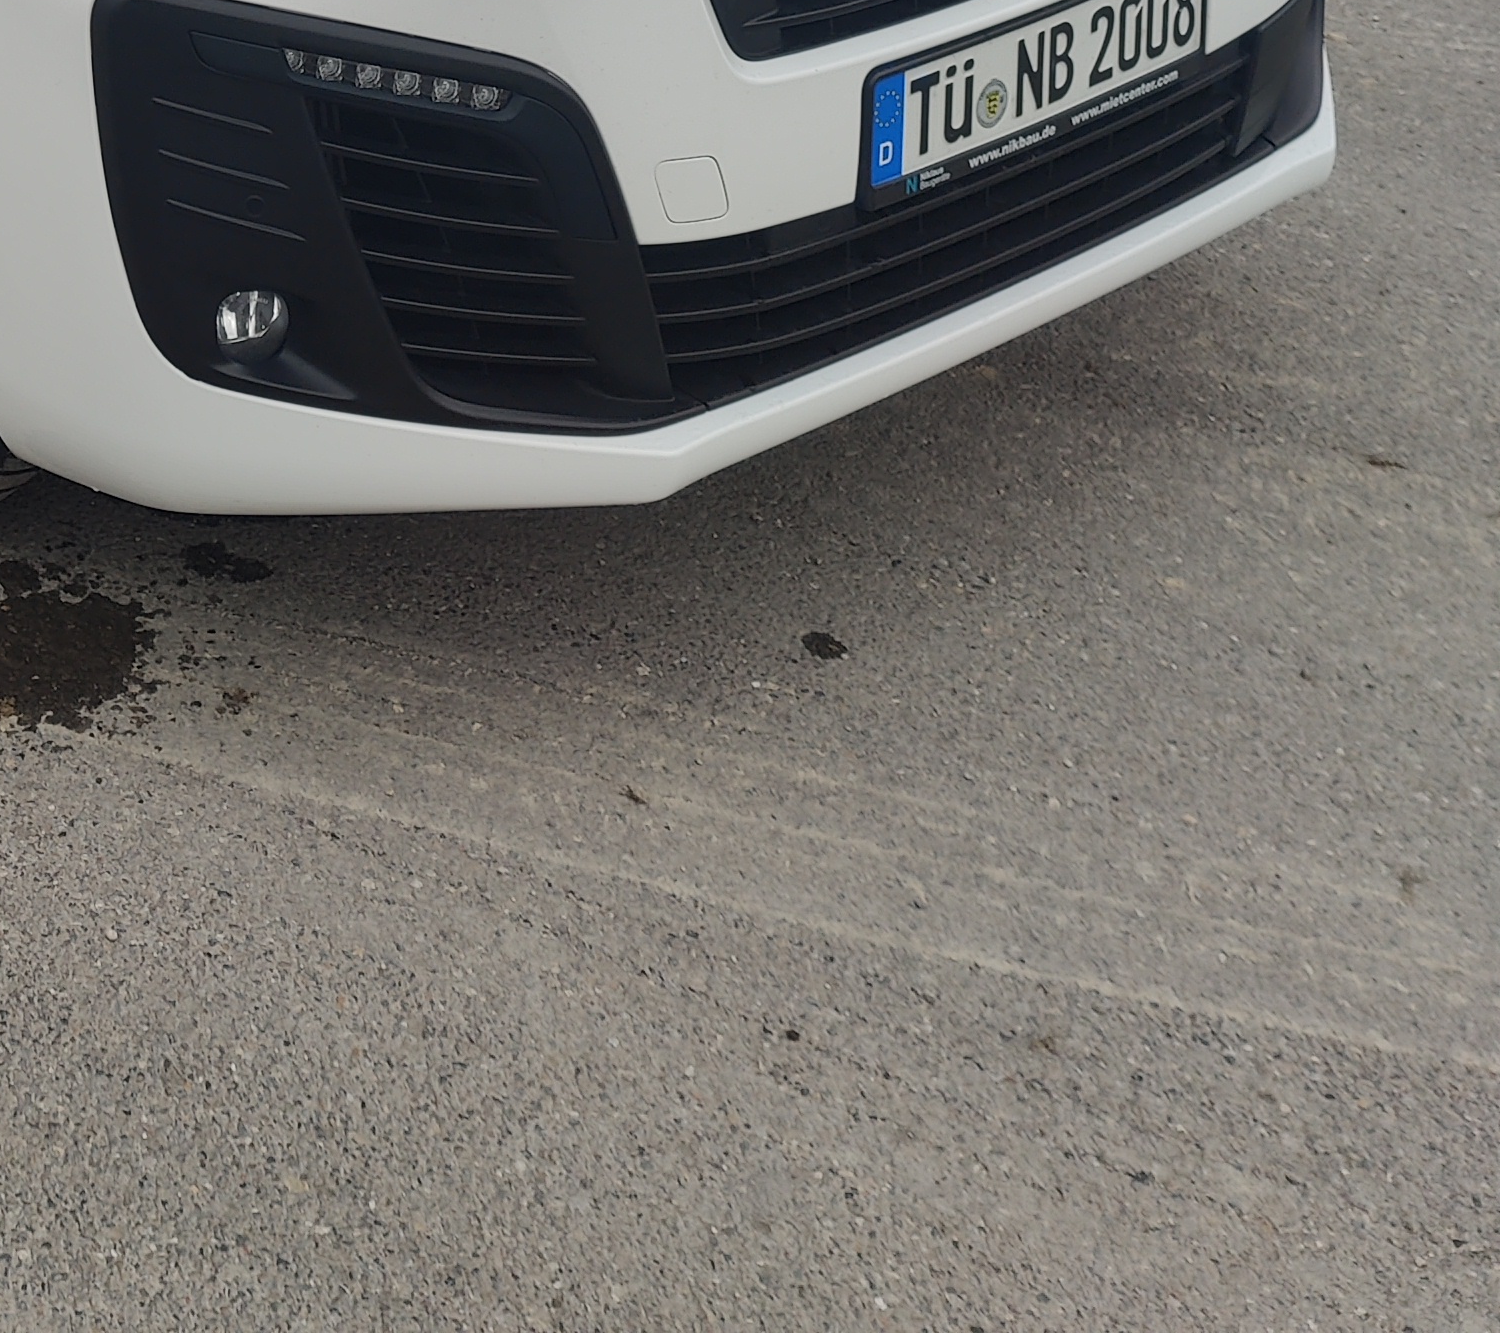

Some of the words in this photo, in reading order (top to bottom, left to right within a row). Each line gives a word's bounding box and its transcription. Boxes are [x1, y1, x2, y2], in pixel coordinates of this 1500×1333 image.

[910, 58, 974, 156] TÜ
[1015, 21, 1075, 118] NB
[968, 123, 1057, 169] www.nikbau.de
[1070, 69, 1180, 126] www.mietcenter.com
[878, 140, 894, 167] D
